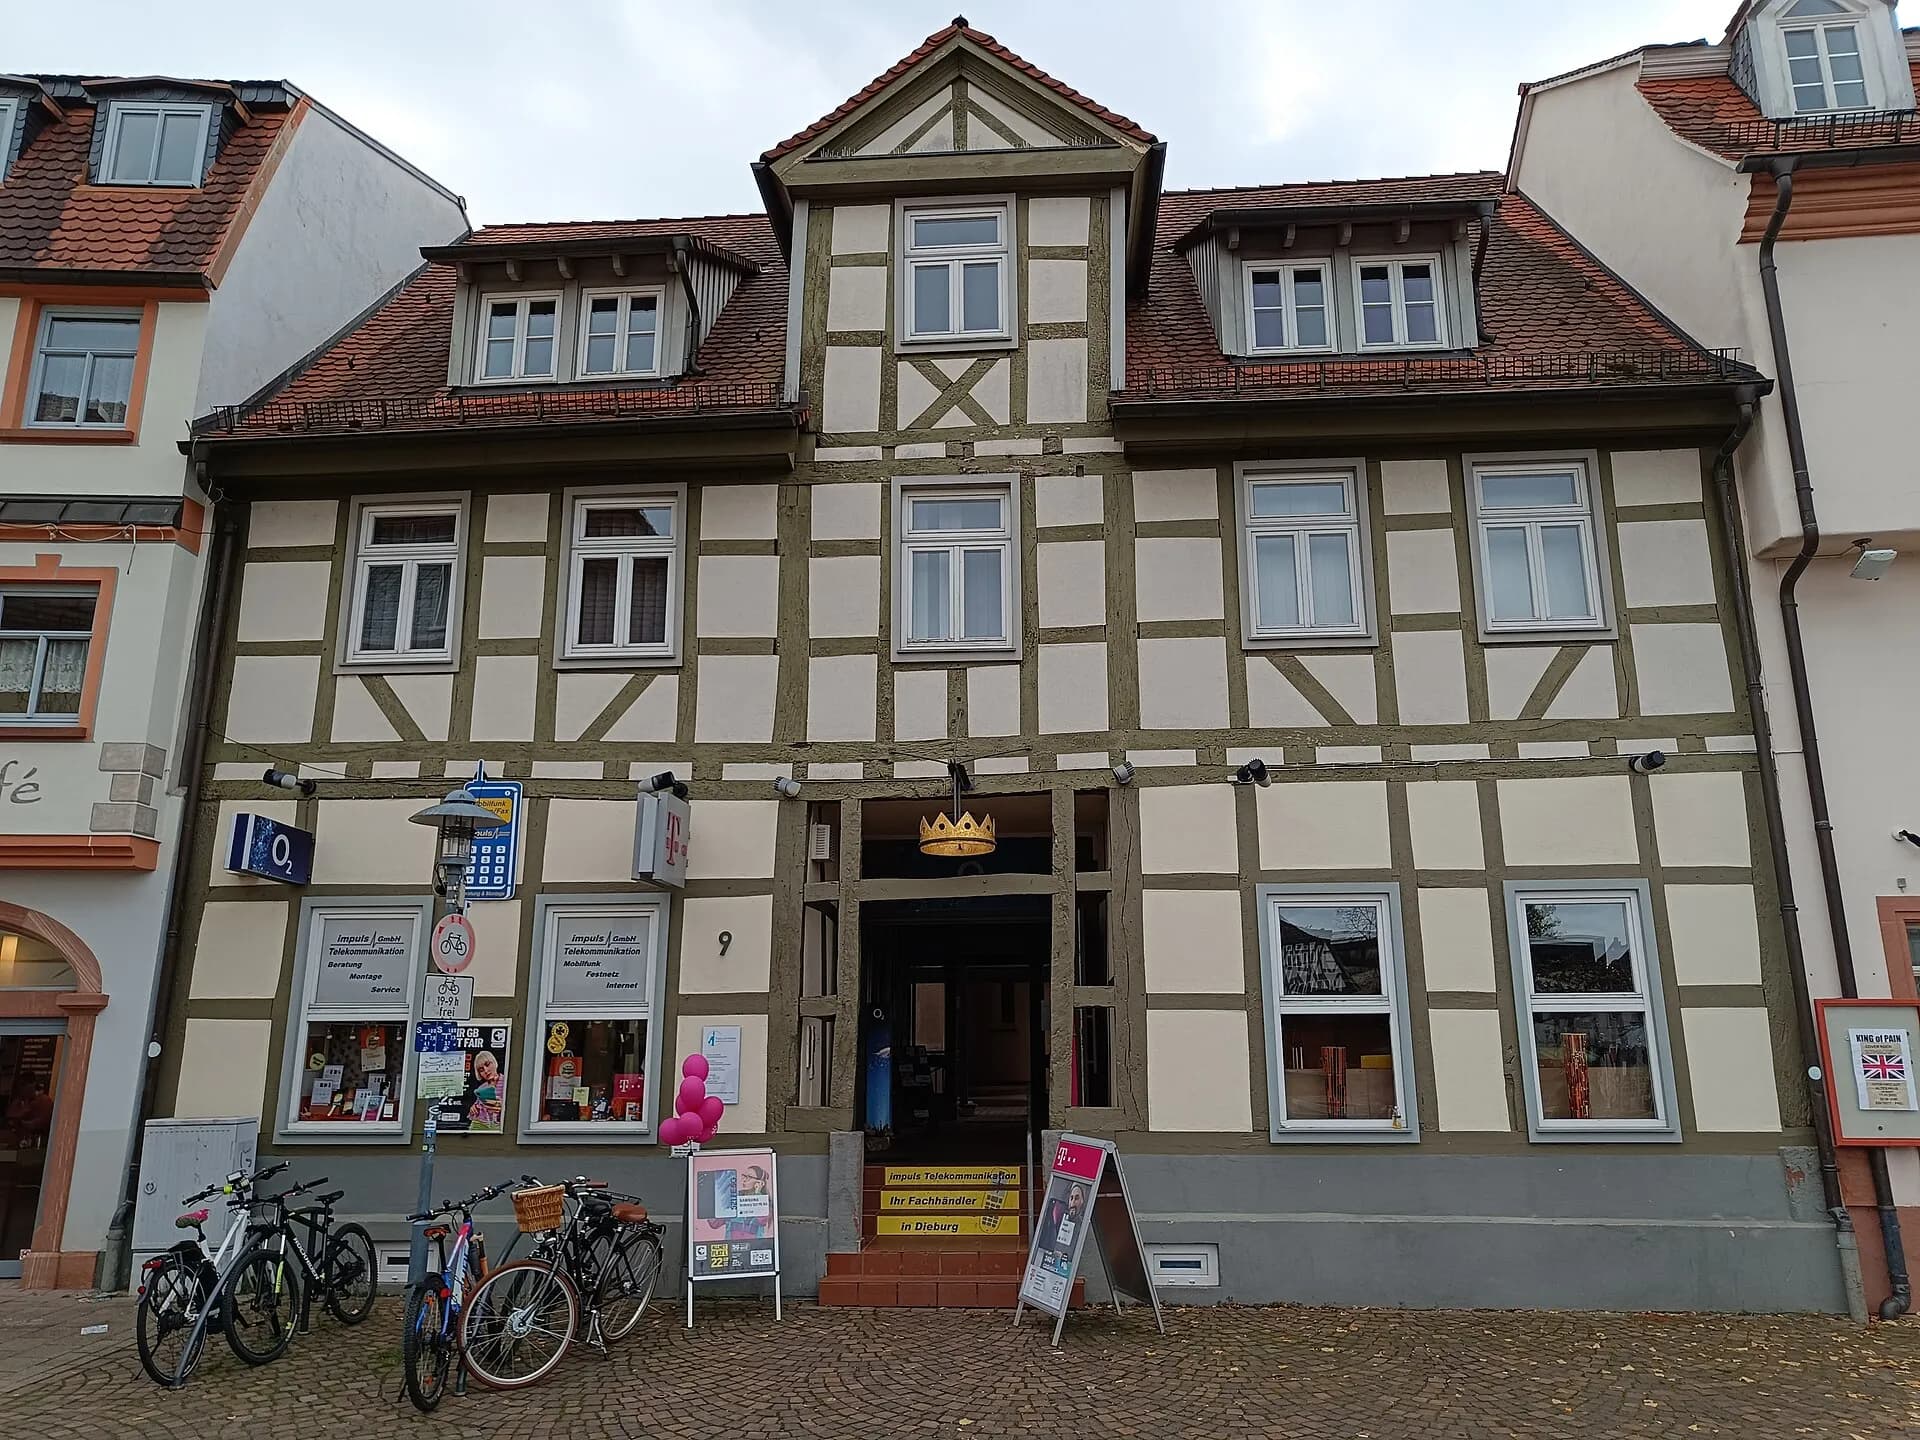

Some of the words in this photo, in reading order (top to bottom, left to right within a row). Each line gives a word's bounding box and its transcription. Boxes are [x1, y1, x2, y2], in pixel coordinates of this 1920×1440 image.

[337, 935, 369, 944] impuls
[377, 935, 401, 943] GmbH
[571, 935, 604, 944] impuls
[612, 935, 637, 943] GmbH
[718, 931, 733, 956] 9
[329, 947, 404, 956] Telekommunikation
[563, 947, 641, 956] Telekommunikation
[327, 961, 363, 969] Beratung
[349, 973, 383, 981] Montage
[585, 970, 620, 978] Festnetz
[437, 996, 454, 1006] 19-9
[454, 997, 460, 1006] h
[439, 1007, 456, 1017] frei
[416, 1026, 423, 1034] S
[437, 1026, 443, 1034] S
[467, 1028, 480, 1038] GB
[464, 1038, 484, 1048] FAIR
[1856, 1034, 1874, 1043] KING
[1884, 1034, 1902, 1043] PAIN
[889, 1171, 921, 1182] impuls
[924, 1170, 1017, 1181] Telekommunikation
[889, 1196, 905, 1206] Ihr
[908, 1196, 977, 1206] Fachhändler
[900, 1222, 911, 1231] in
[914, 1221, 959, 1233] Dieburg
